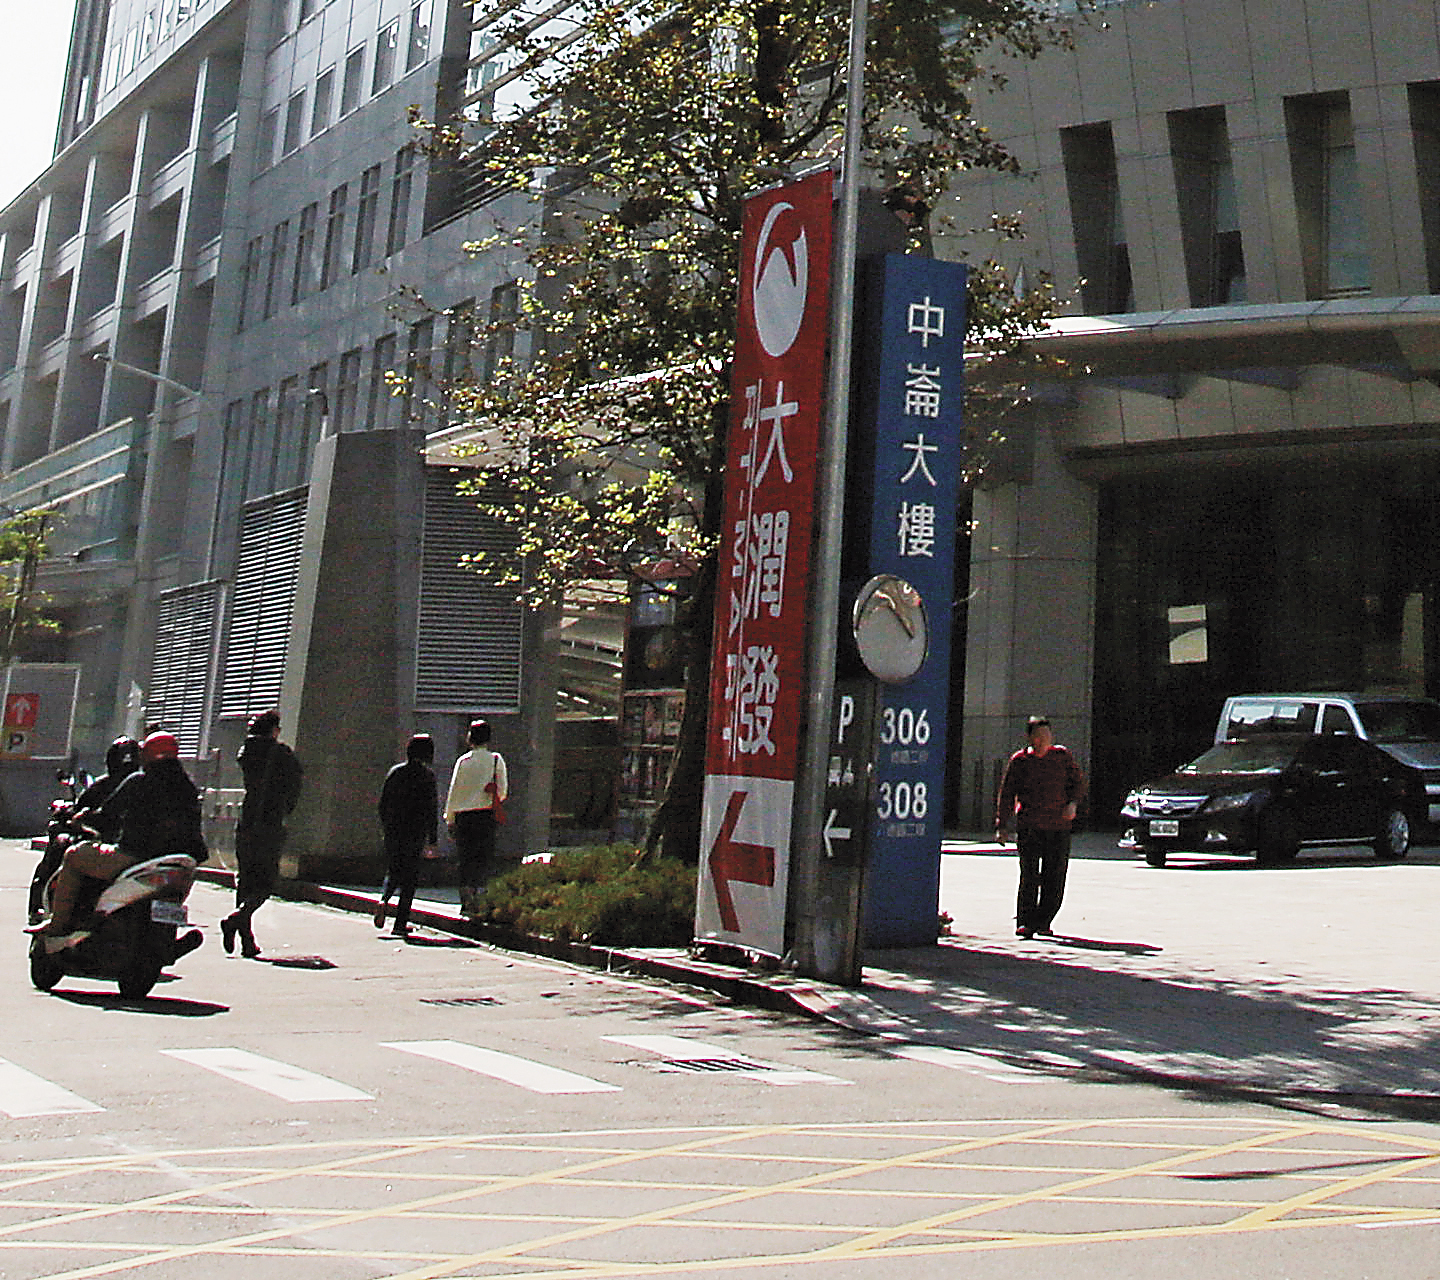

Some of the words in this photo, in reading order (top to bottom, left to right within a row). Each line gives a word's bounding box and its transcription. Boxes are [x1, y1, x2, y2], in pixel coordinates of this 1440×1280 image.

[898, 295, 945, 558] 中崙大樓
[738, 380, 799, 757] 大潤發
[837, 695, 855, 744] P
[880, 707, 931, 744] 306
[876, 781, 928, 819] 308
